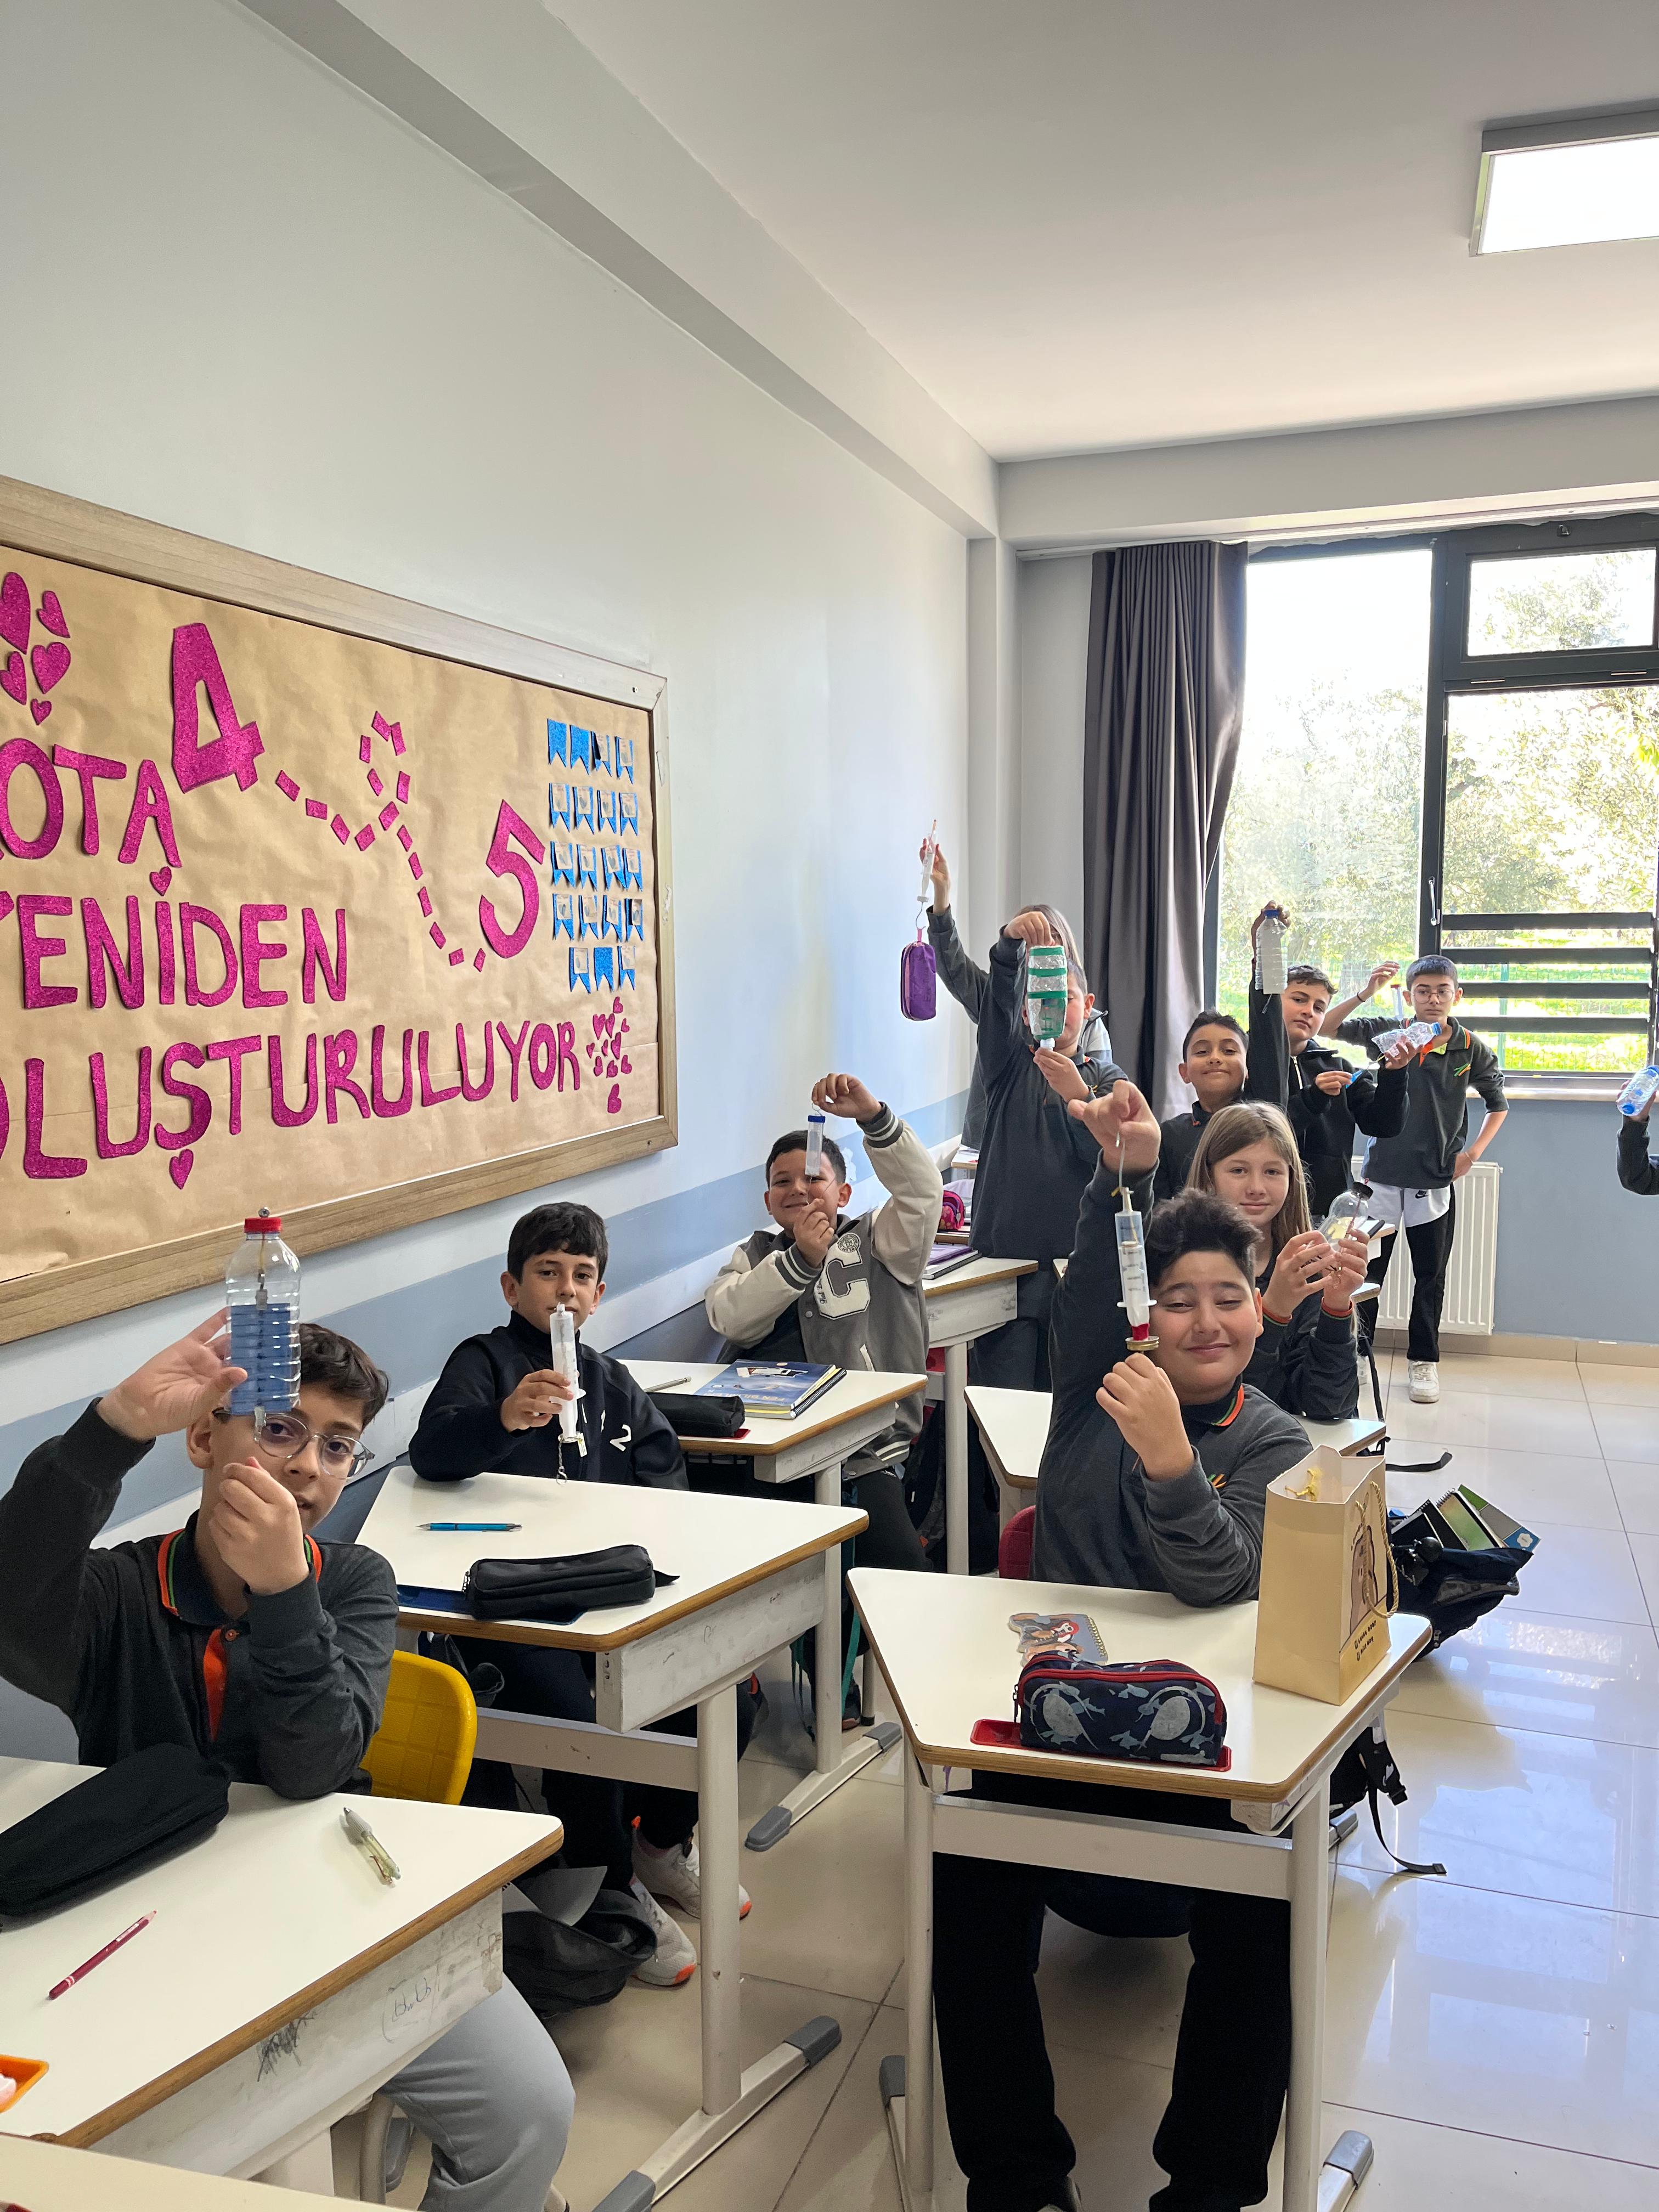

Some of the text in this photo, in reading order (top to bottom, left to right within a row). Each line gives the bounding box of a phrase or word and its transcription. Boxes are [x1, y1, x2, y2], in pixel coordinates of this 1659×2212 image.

[0, 622, 265, 868] OTA 4
[0, 866, 347, 1010] ENİDEN
[479, 799, 545, 959] 5
[0, 1020, 580, 1190] LUŞTURULUYOR
